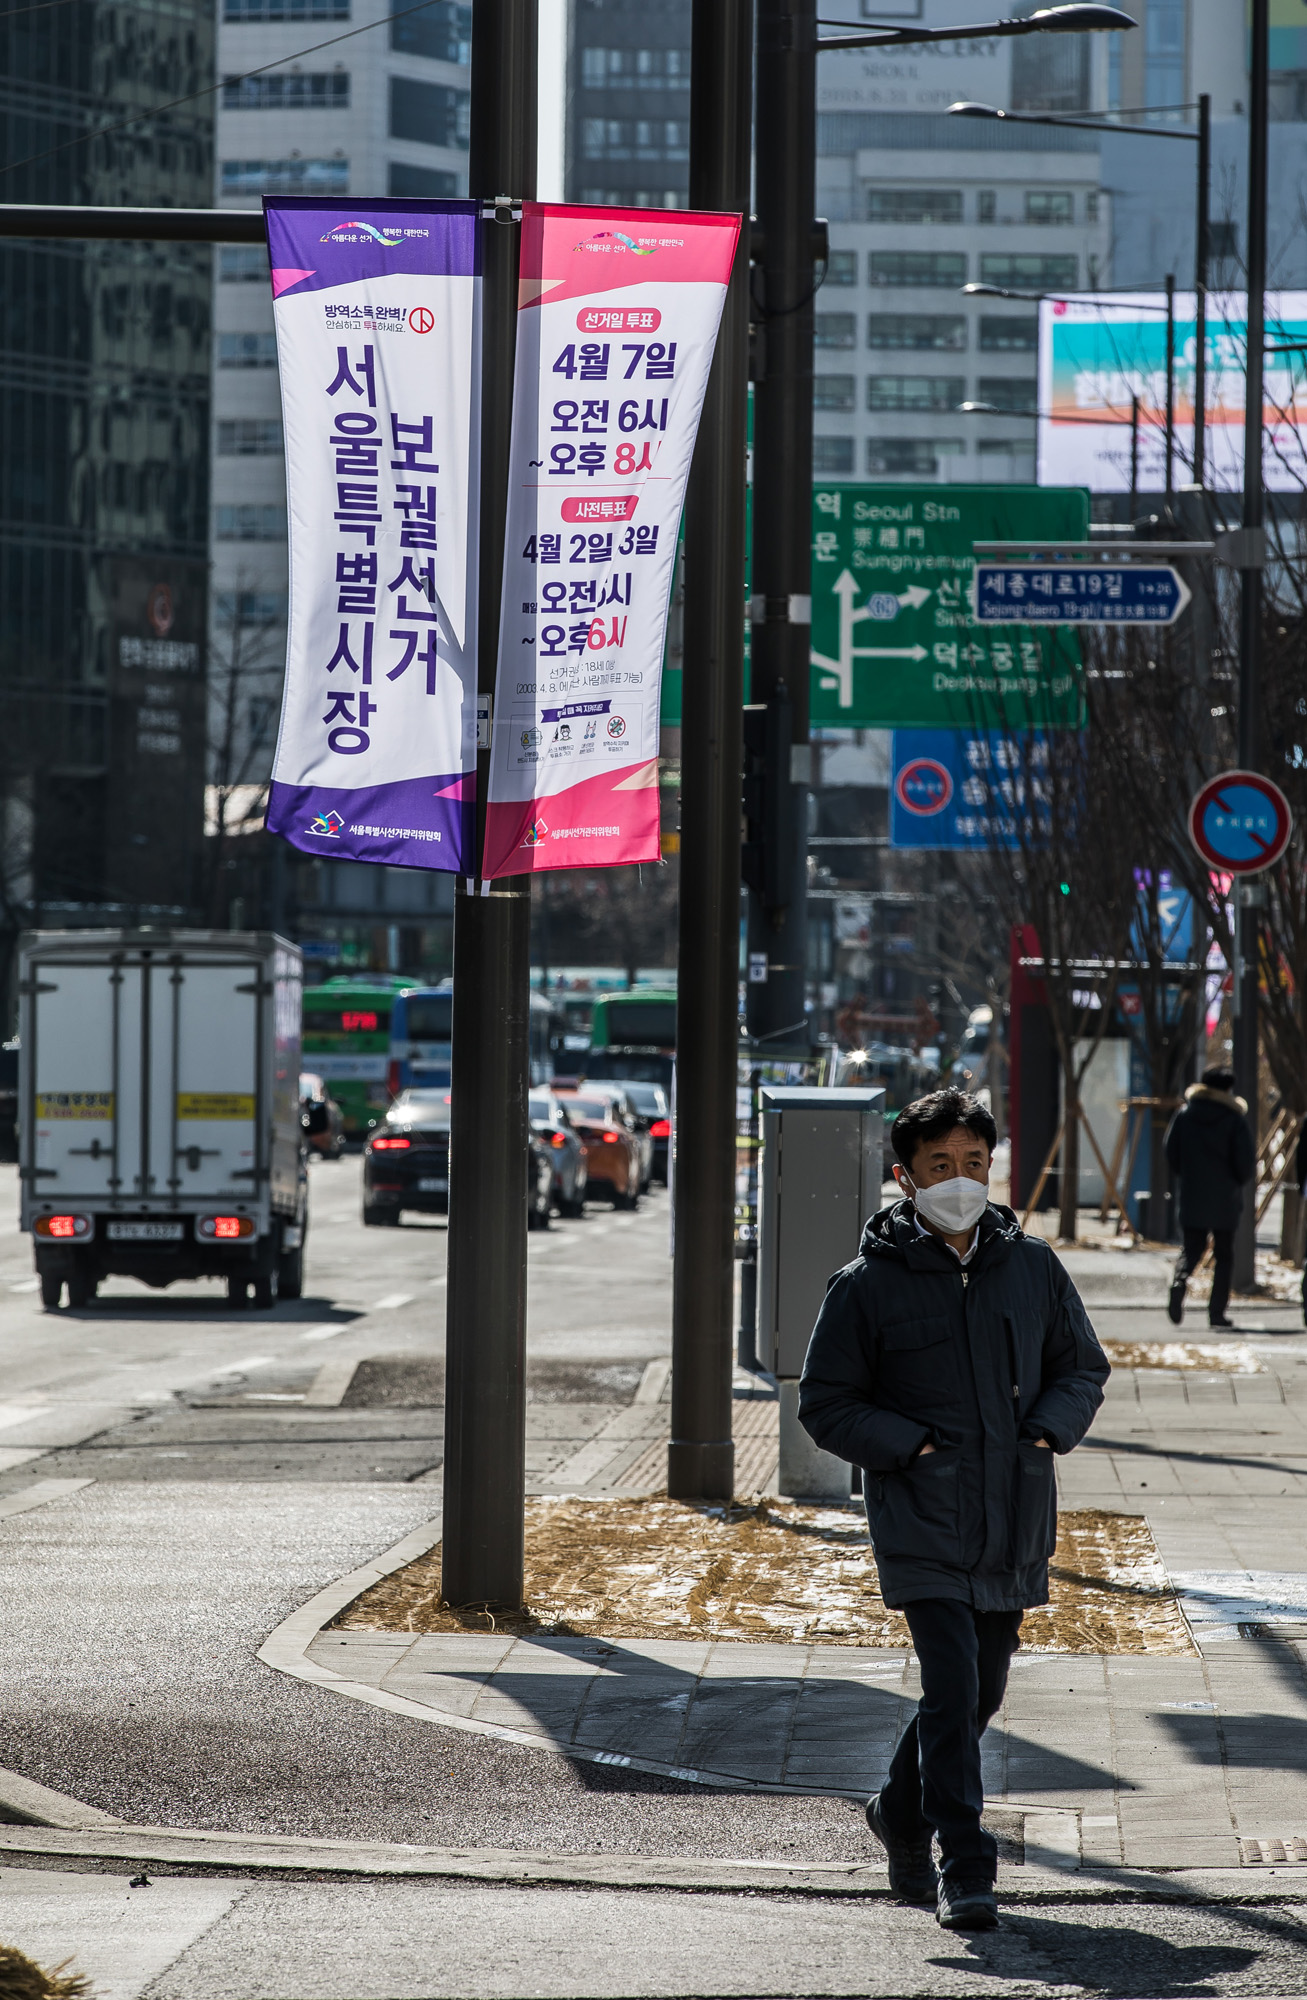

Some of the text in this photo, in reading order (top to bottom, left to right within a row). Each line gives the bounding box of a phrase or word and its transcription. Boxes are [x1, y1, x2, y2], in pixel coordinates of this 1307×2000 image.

[331, 234, 373, 243] 아름다운 선거
[382, 228, 430, 238] 행복한 대한민국
[638, 238, 684, 248] 행복한 대한민국
[585, 243, 626, 253] 아름다운 선거
[324, 304, 407, 322] 방역소독 완벽!
[585, 312, 654, 329] 선거일 투표
[326, 320, 406, 333] 안심하고 투표하세요.
[552, 342, 677, 381] 4월 7일
[550, 398, 669, 433] 오전 6시
[575, 501, 627, 518] 사전투표
[853, 501, 960, 522] Seoul Stn
[322, 345, 383, 755] 서울특별시장
[386, 413, 439, 695] 보궐선거
[522, 525, 659, 564] 4월 2일 3일
[983, 572, 1123, 598] 세종대로19길
[540, 580, 597, 615] 오전
[587, 615, 628, 650] 6시
[932, 641, 1042, 672] 덕수궁길
[349, 824, 442, 842] 서울특별시선거관리위원회
